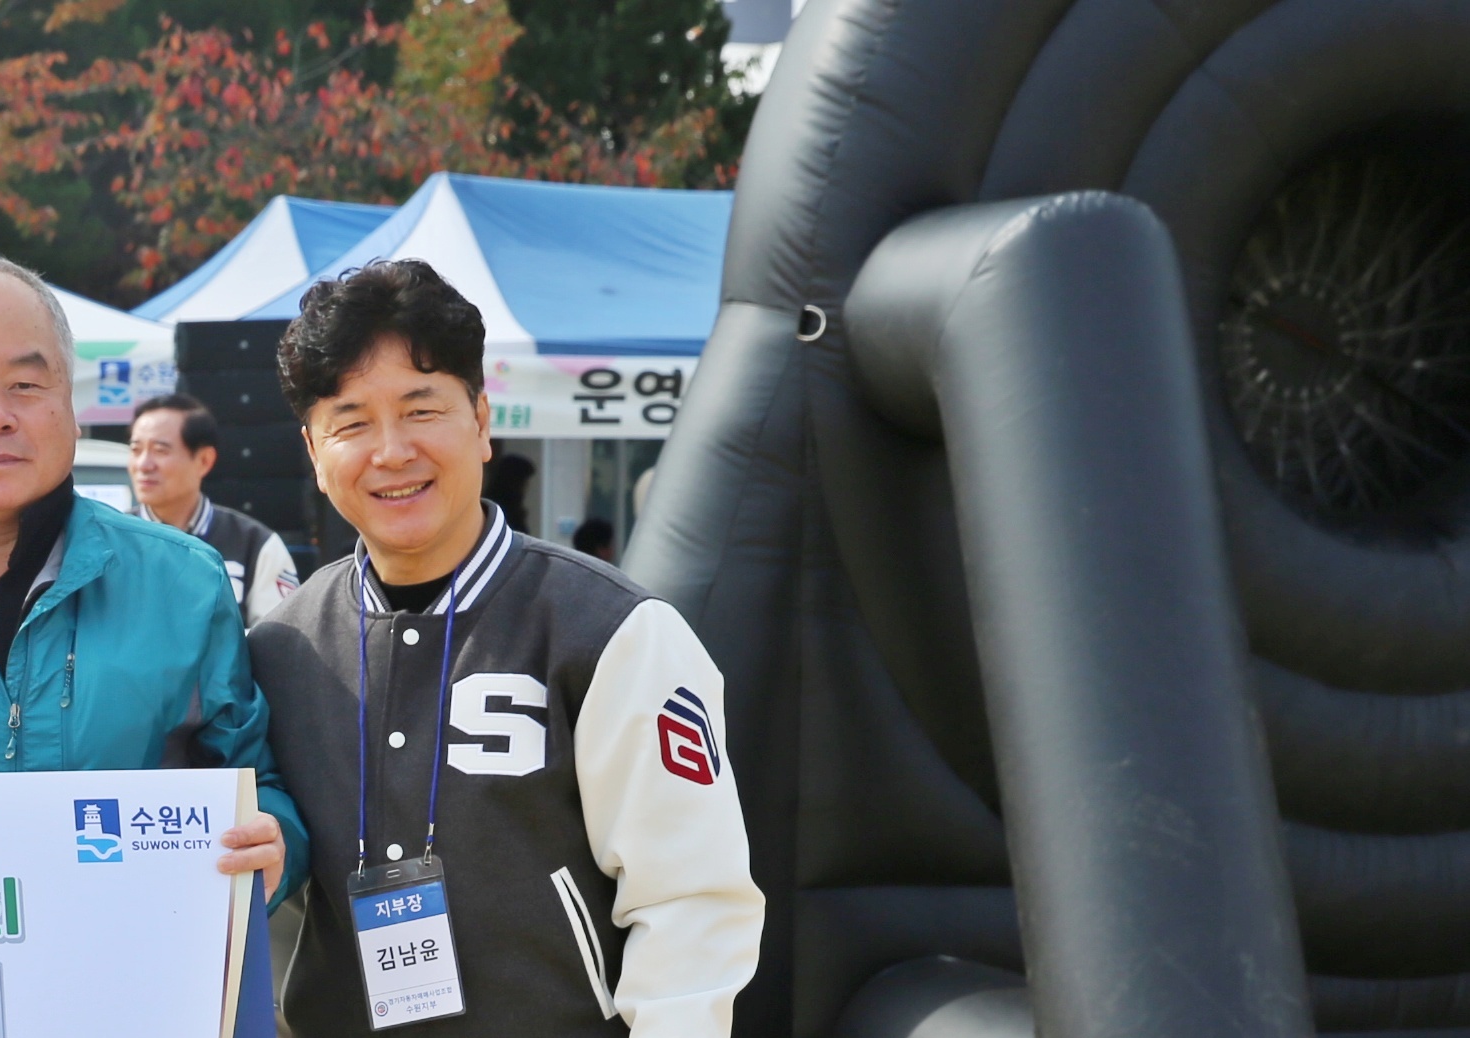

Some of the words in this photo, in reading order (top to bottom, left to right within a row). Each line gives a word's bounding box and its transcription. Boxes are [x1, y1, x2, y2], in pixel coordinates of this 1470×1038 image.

[573, 368, 683, 425] 운영
[447, 673, 547, 776] S
[130, 805, 210, 836] 수원시
[131, 840, 180, 851] SUWON
[183, 839, 212, 850] CITY
[374, 893, 423, 918] 지부장
[377, 939, 439, 971] 김남윤
[406, 1001, 438, 1014] 수원지부
